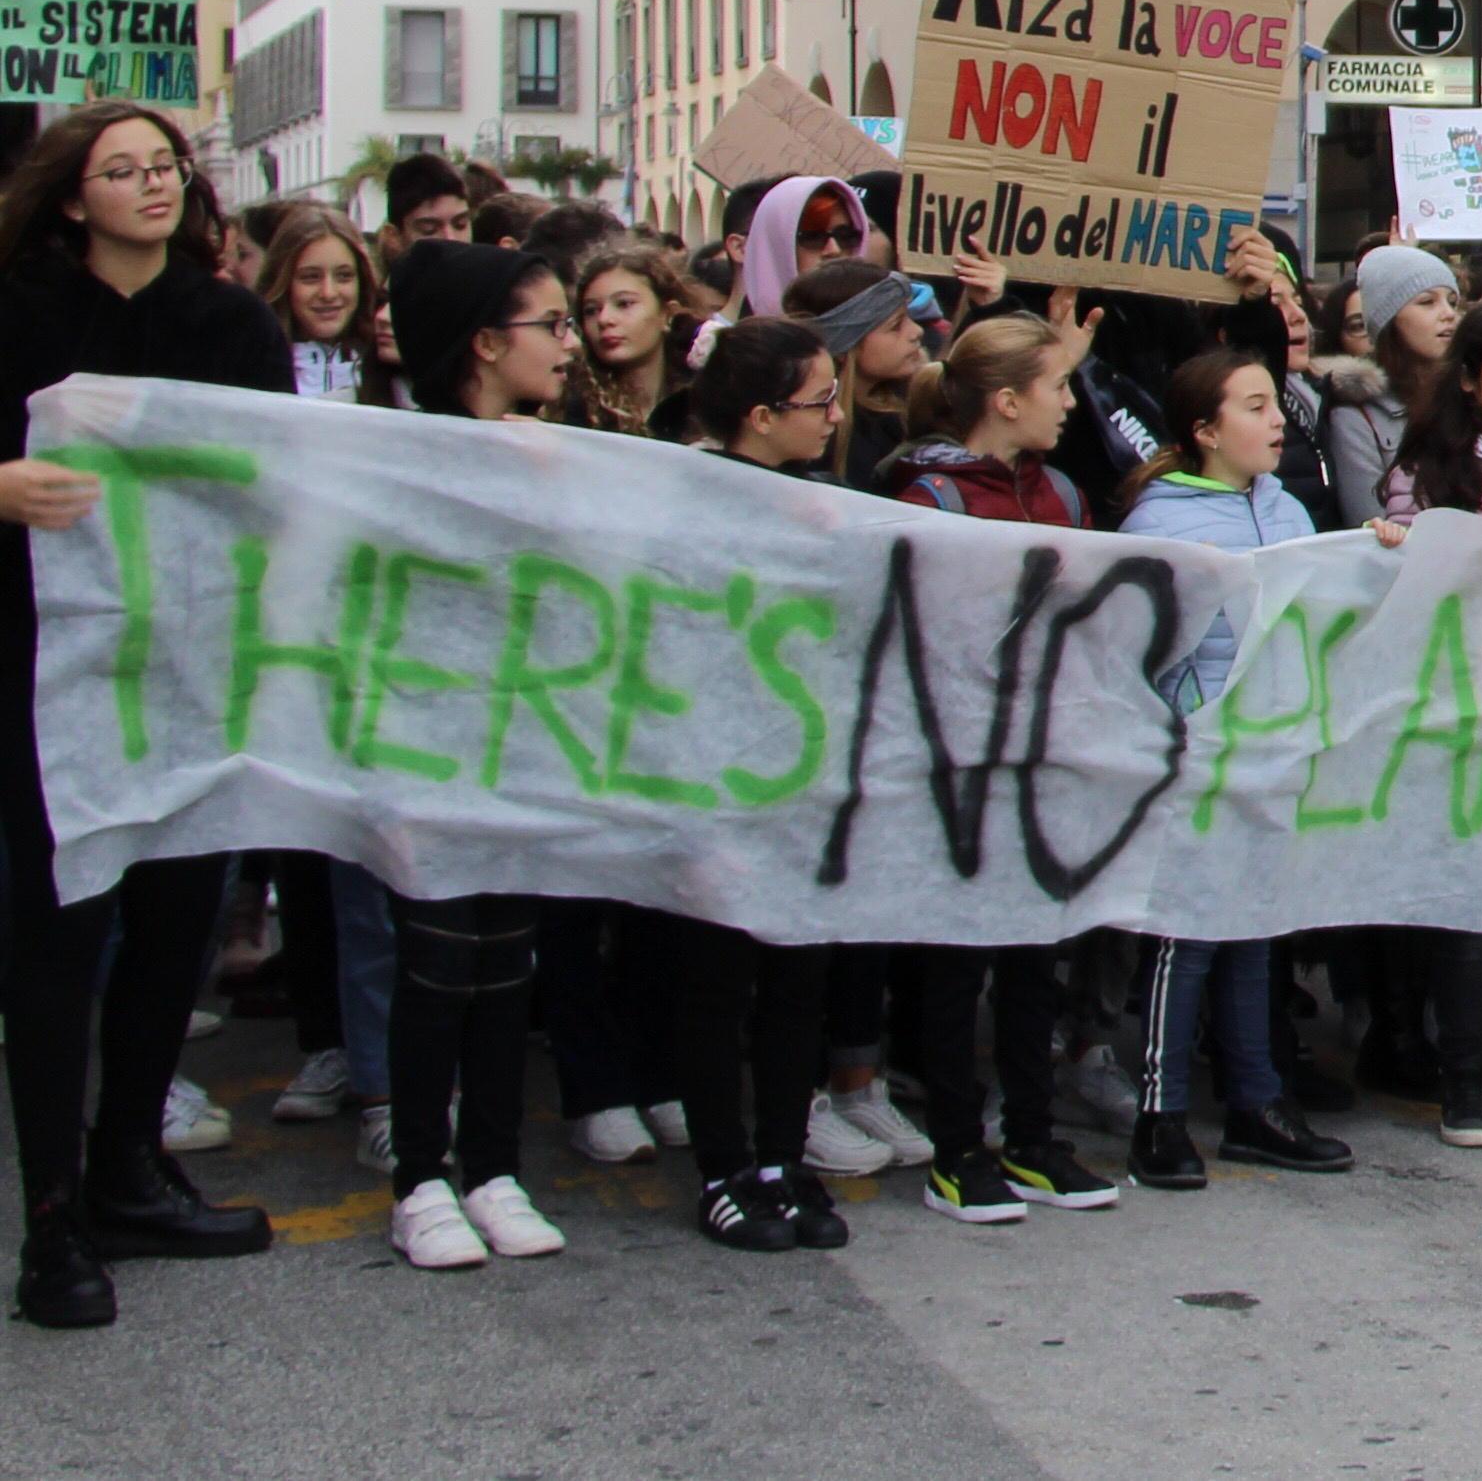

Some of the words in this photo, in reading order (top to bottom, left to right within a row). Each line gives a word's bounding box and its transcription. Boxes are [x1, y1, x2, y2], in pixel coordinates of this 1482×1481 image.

[39, 0, 198, 46] SISTEMA
[1175, 3, 1287, 69] VOCE
[0, 45, 58, 94] ON
[87, 50, 198, 100] CLIMA
[1327, 62, 1424, 77] FARMACIA
[1327, 78, 1435, 95] COMUNALE
[948, 58, 1103, 163] NON
[1137, 92, 1179, 178] il
[907, 173, 1047, 257] livello
[1054, 195, 1121, 262] del
[1121, 198, 1255, 275] MARE
[1109, 407, 1160, 464] NIKE
[816, 535, 1192, 905] NO
